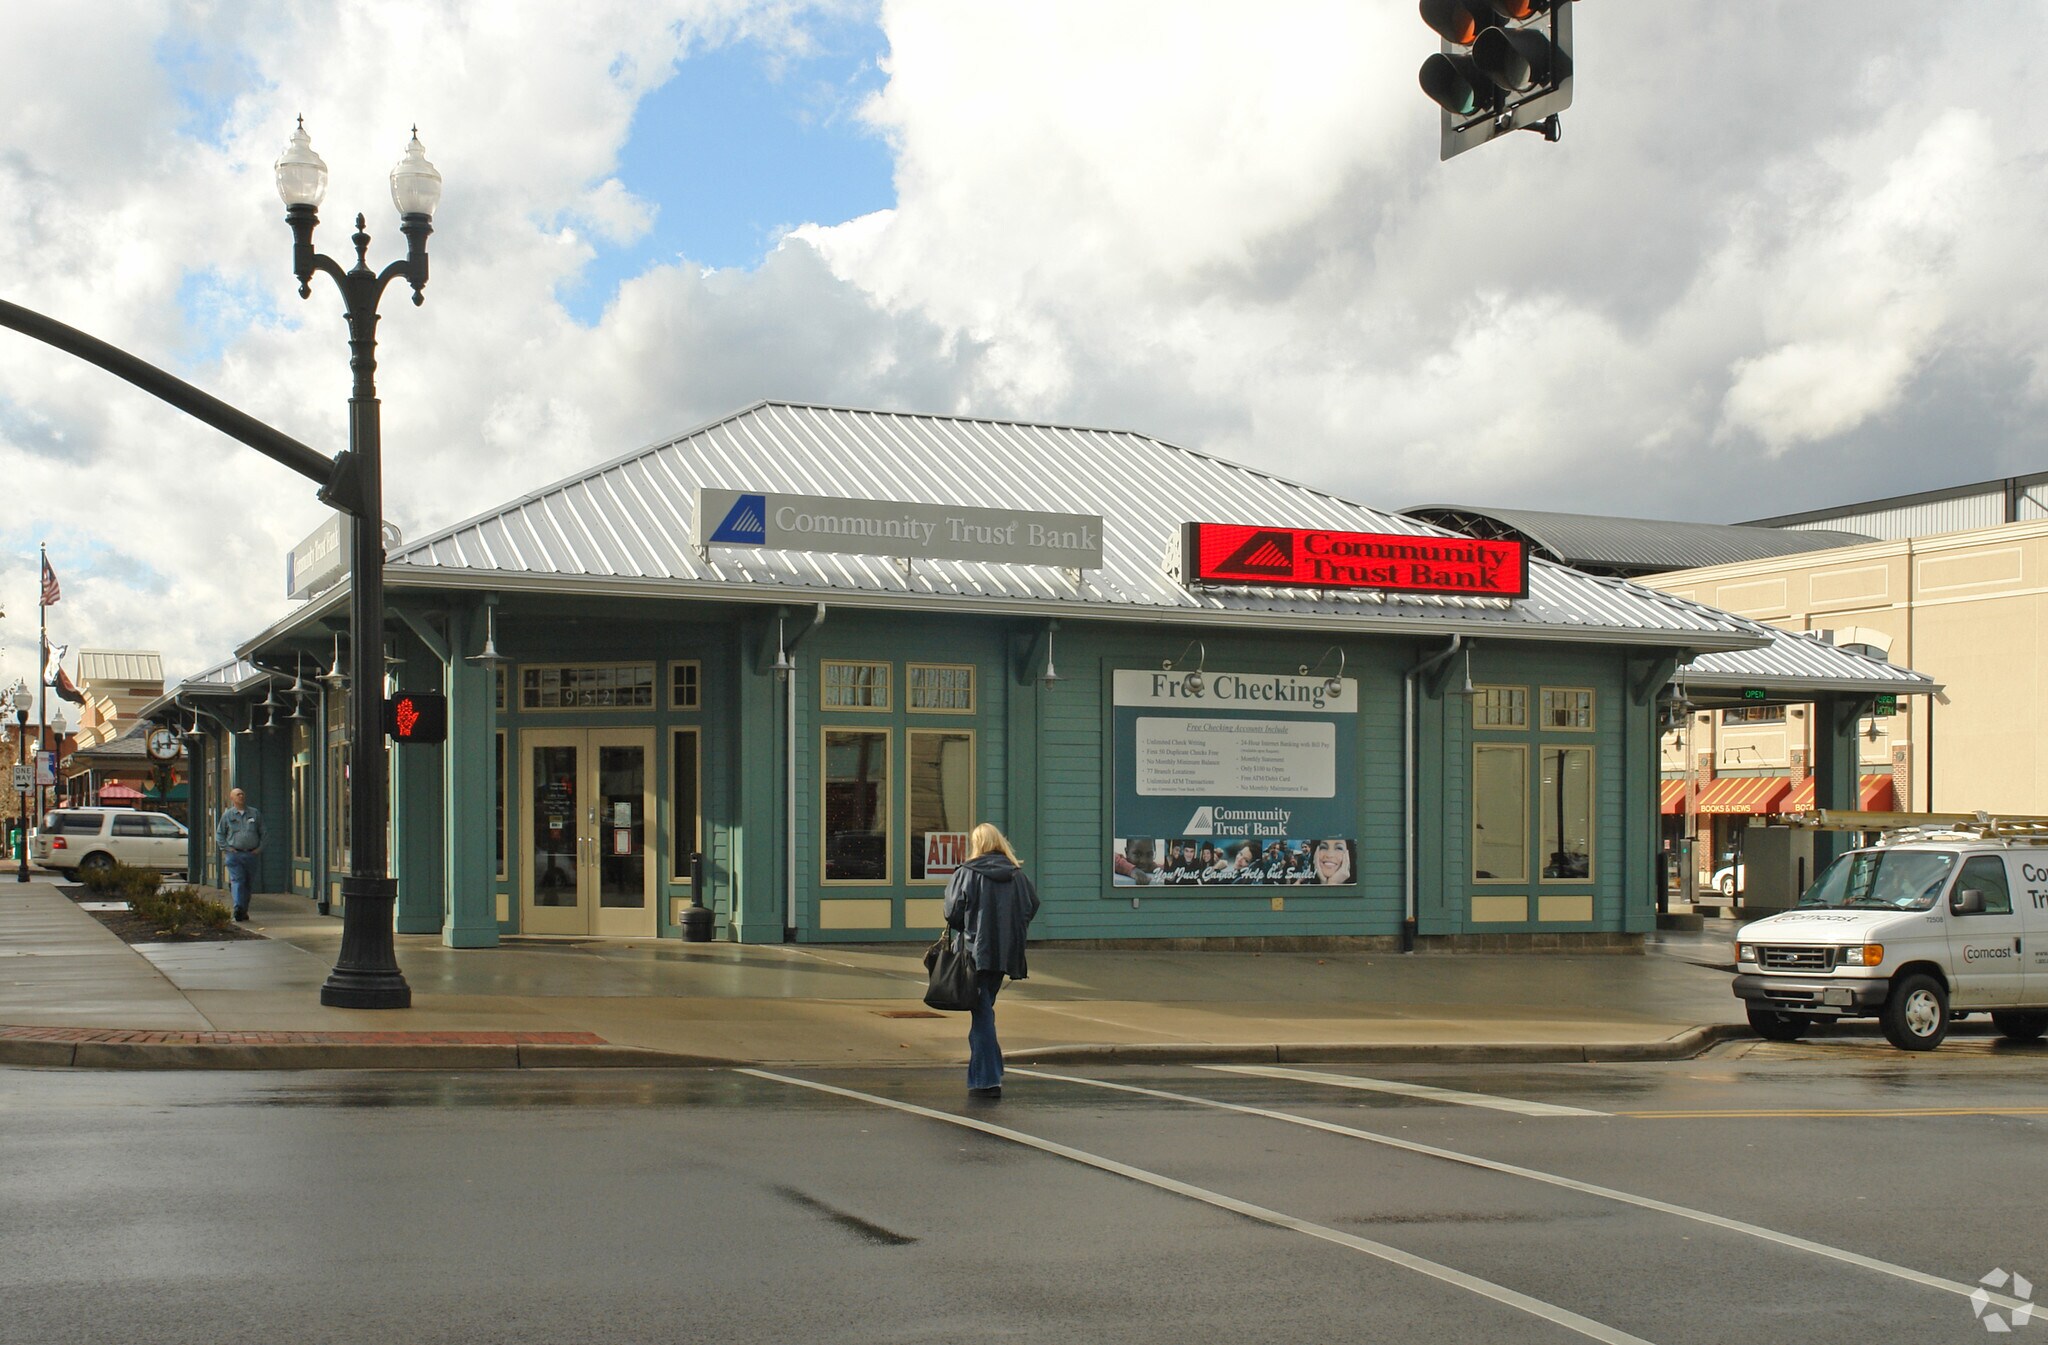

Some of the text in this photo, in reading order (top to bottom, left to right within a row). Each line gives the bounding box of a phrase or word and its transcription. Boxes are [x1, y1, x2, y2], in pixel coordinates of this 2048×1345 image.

[774, 505, 937, 547] Community
[1028, 524, 1097, 552] Bank
[1304, 533, 1507, 571] Community
[1305, 557, 1500, 589] Trust Bank
[565, 690, 610, 705] 952
[1213, 675, 1326, 709] Checking
[1745, 690, 1764, 698] OPEN
[1877, 695, 1895, 703] OPEN
[1877, 706, 1894, 714] ATM
[1186, 723, 1289, 734] Free Checking Accounts Include
[1214, 806, 1292, 824] Community
[1700, 804, 1724, 812] BOOKS
[1731, 804, 1751, 812] NEWS
[1214, 822, 1287, 836] Trust Bank
[927, 834, 966, 865] ATM
[1202, 866, 1238, 881] Cannot
[1240, 867, 1265, 882] Help
[1267, 863, 1283, 879] but
[2022, 863, 2048, 883] Co
